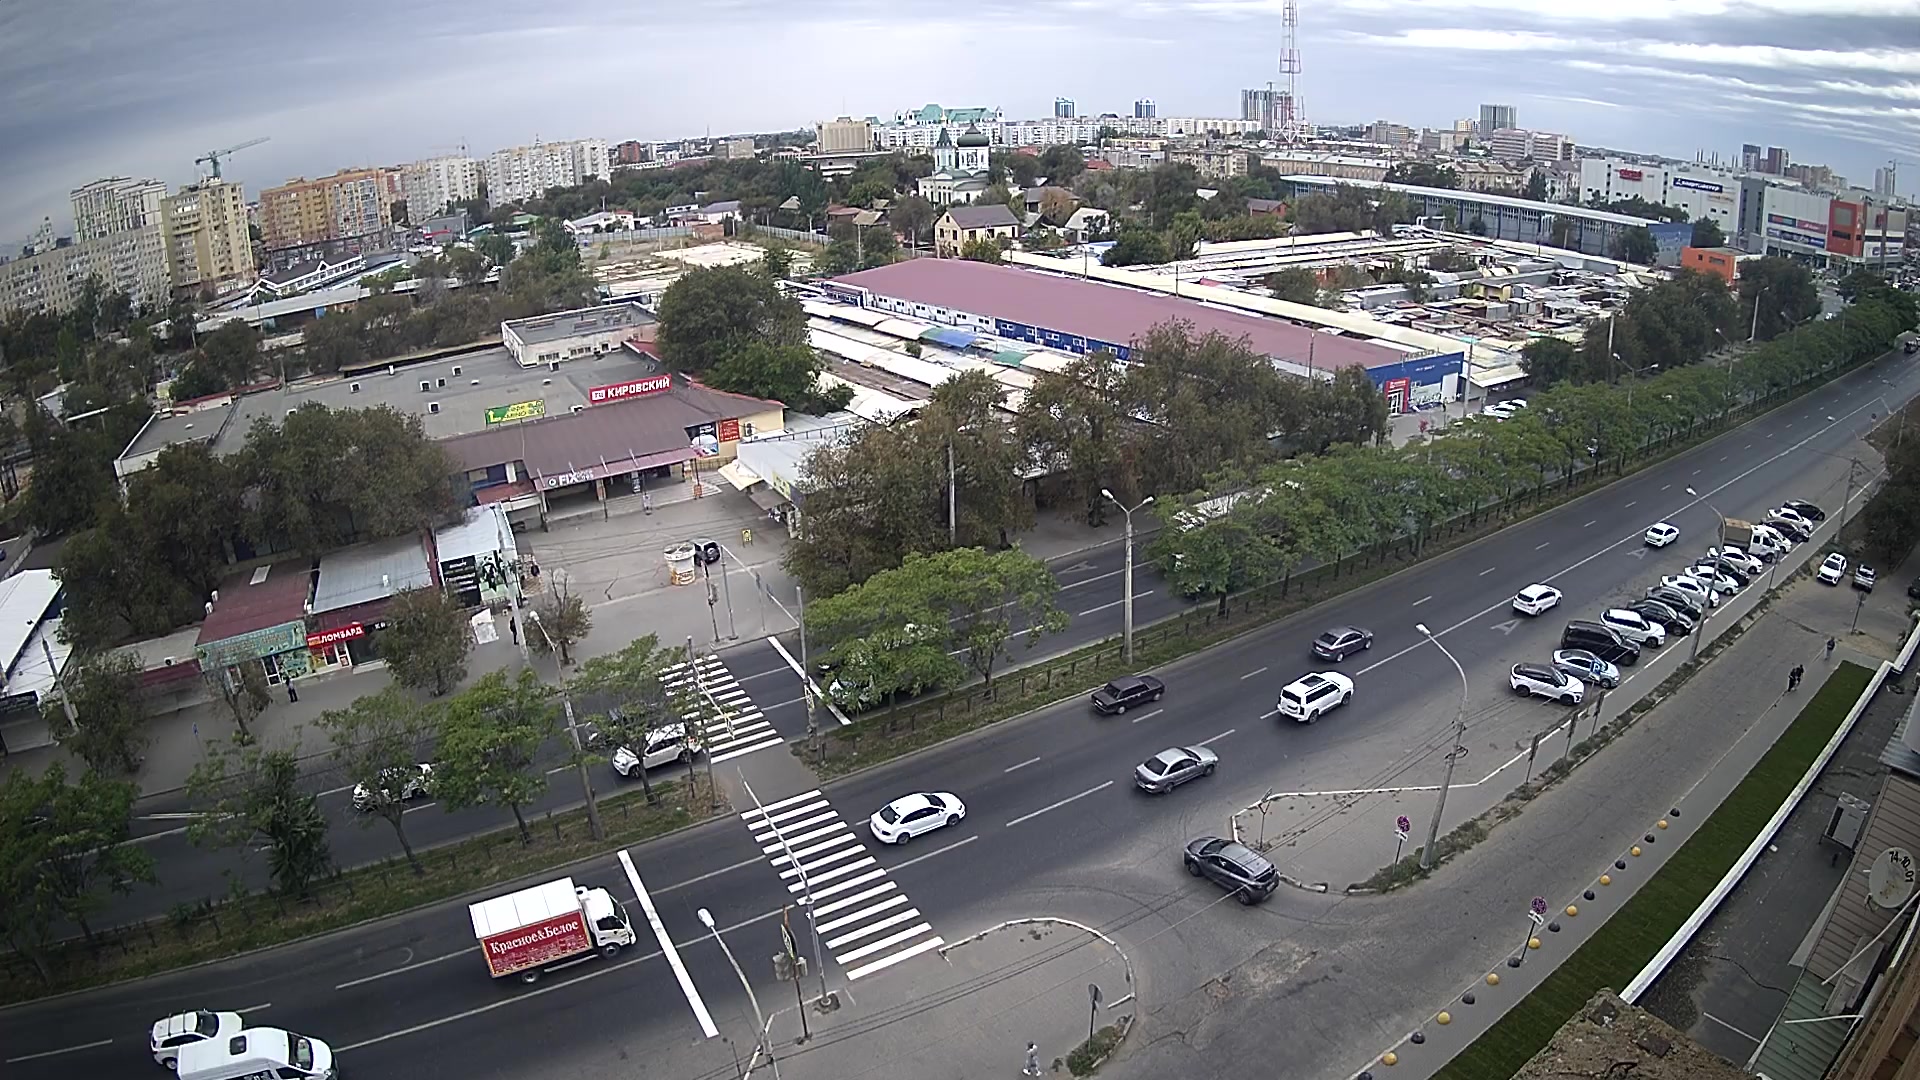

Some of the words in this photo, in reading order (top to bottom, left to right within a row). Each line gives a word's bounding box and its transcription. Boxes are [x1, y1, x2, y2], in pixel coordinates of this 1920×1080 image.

[607, 376, 670, 399] КИРОВСКИЙ
[558, 472, 579, 486] FIX
[321, 626, 365, 644] ЛОМБАРД
[489, 919, 579, 955] Красное&Белое
